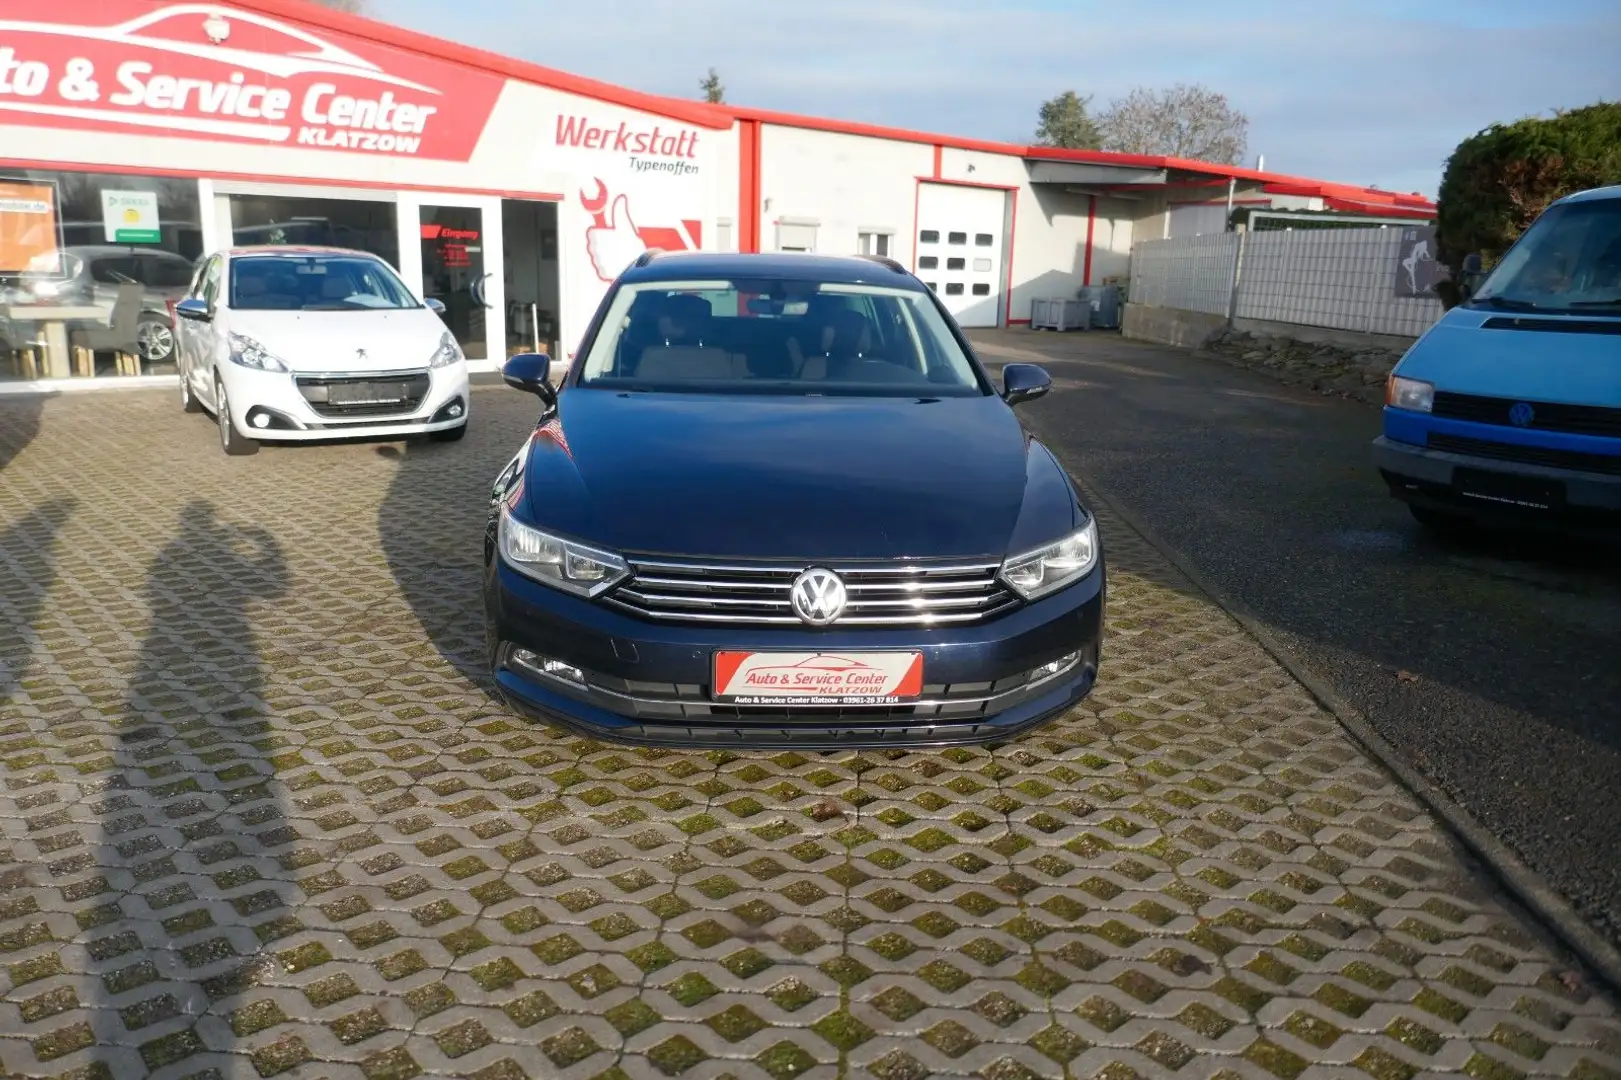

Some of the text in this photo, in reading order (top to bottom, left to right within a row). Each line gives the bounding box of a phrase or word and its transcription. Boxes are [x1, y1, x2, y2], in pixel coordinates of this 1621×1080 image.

[57, 57, 100, 101] &
[109, 60, 292, 120] Service
[302, 82, 437, 134] Center
[297, 127, 421, 153] KLATZOW
[556, 114, 700, 158] Werkstatt
[628, 157, 699, 175] Typenoffen
[745, 672, 888, 685] Auto & Service Center
[819, 686, 882, 694] KLATZOW
[734, 696, 752, 704] Auto
[761, 696, 786, 704] Service
[811, 696, 838, 704] Klatzow
